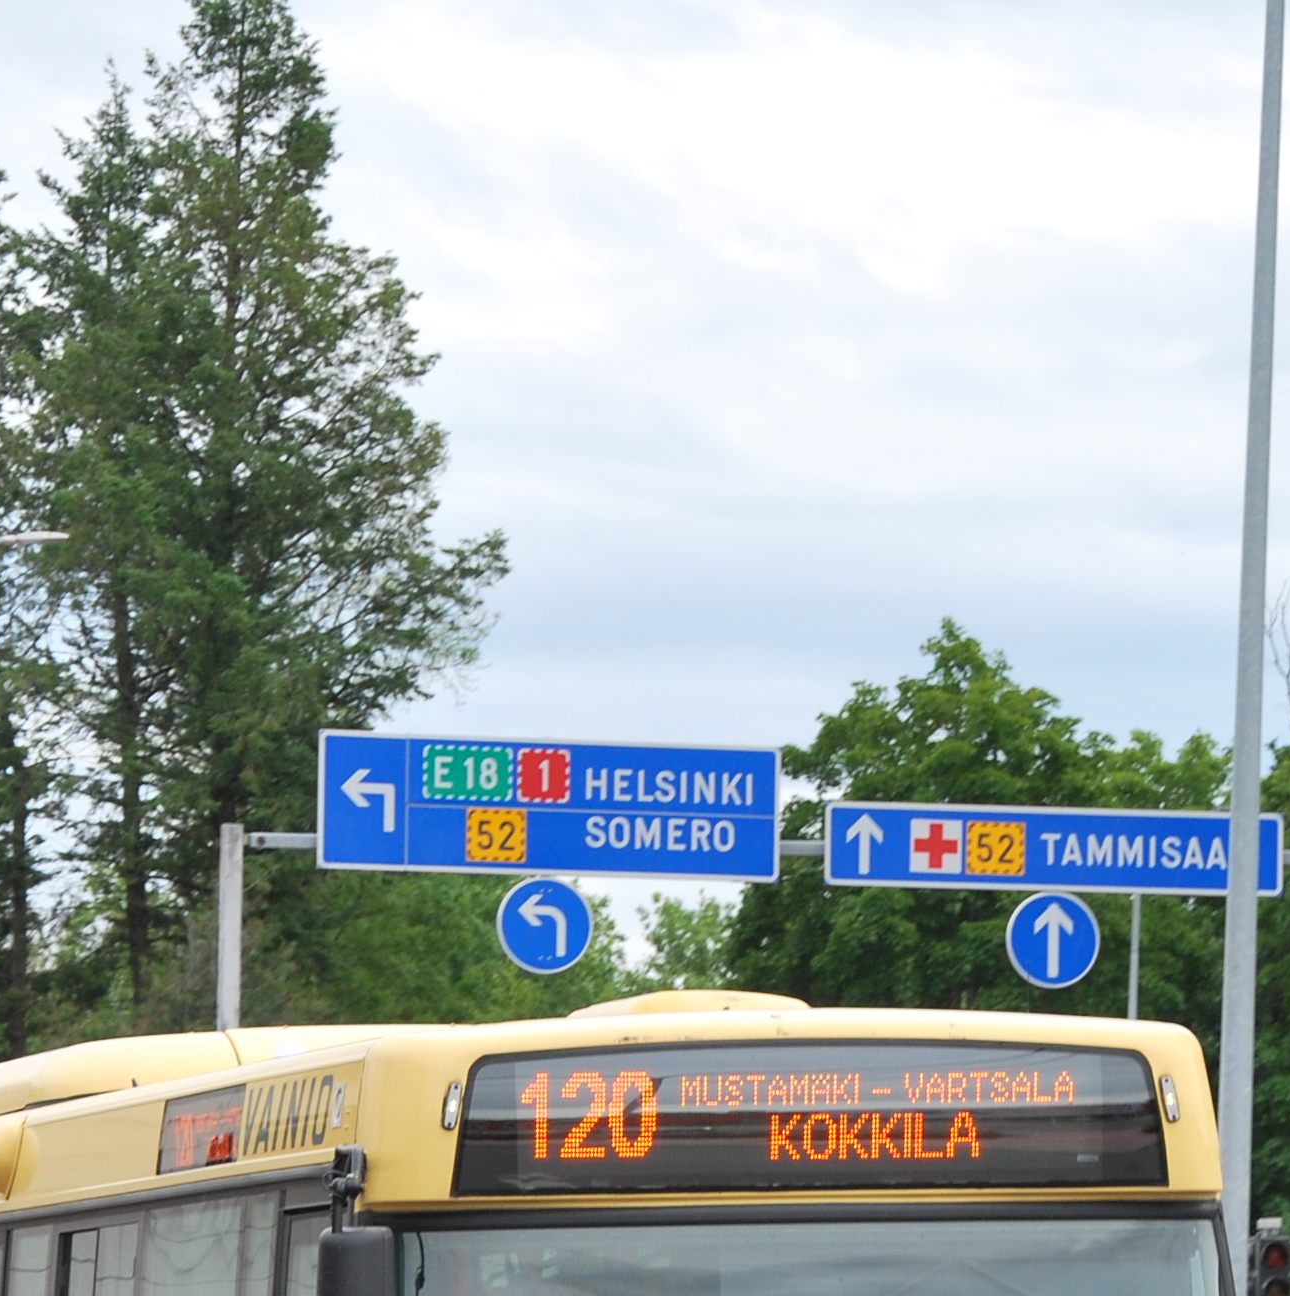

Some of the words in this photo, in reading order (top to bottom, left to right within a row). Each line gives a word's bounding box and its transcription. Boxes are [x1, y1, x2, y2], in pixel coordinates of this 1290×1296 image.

[538, 759, 550, 792] 1
[584, 767, 755, 806] HELSINKI
[477, 820, 515, 851] 52
[584, 816, 736, 852] SOMERO
[975, 834, 1015, 864] 52
[1040, 832, 1228, 871] TAMMISAA
[903, 1069, 1075, 1104] VARTSALA
[242, 1074, 333, 1156] VAINIO
[520, 1070, 658, 1159] 120
[769, 1110, 981, 1161] KOKKILA
